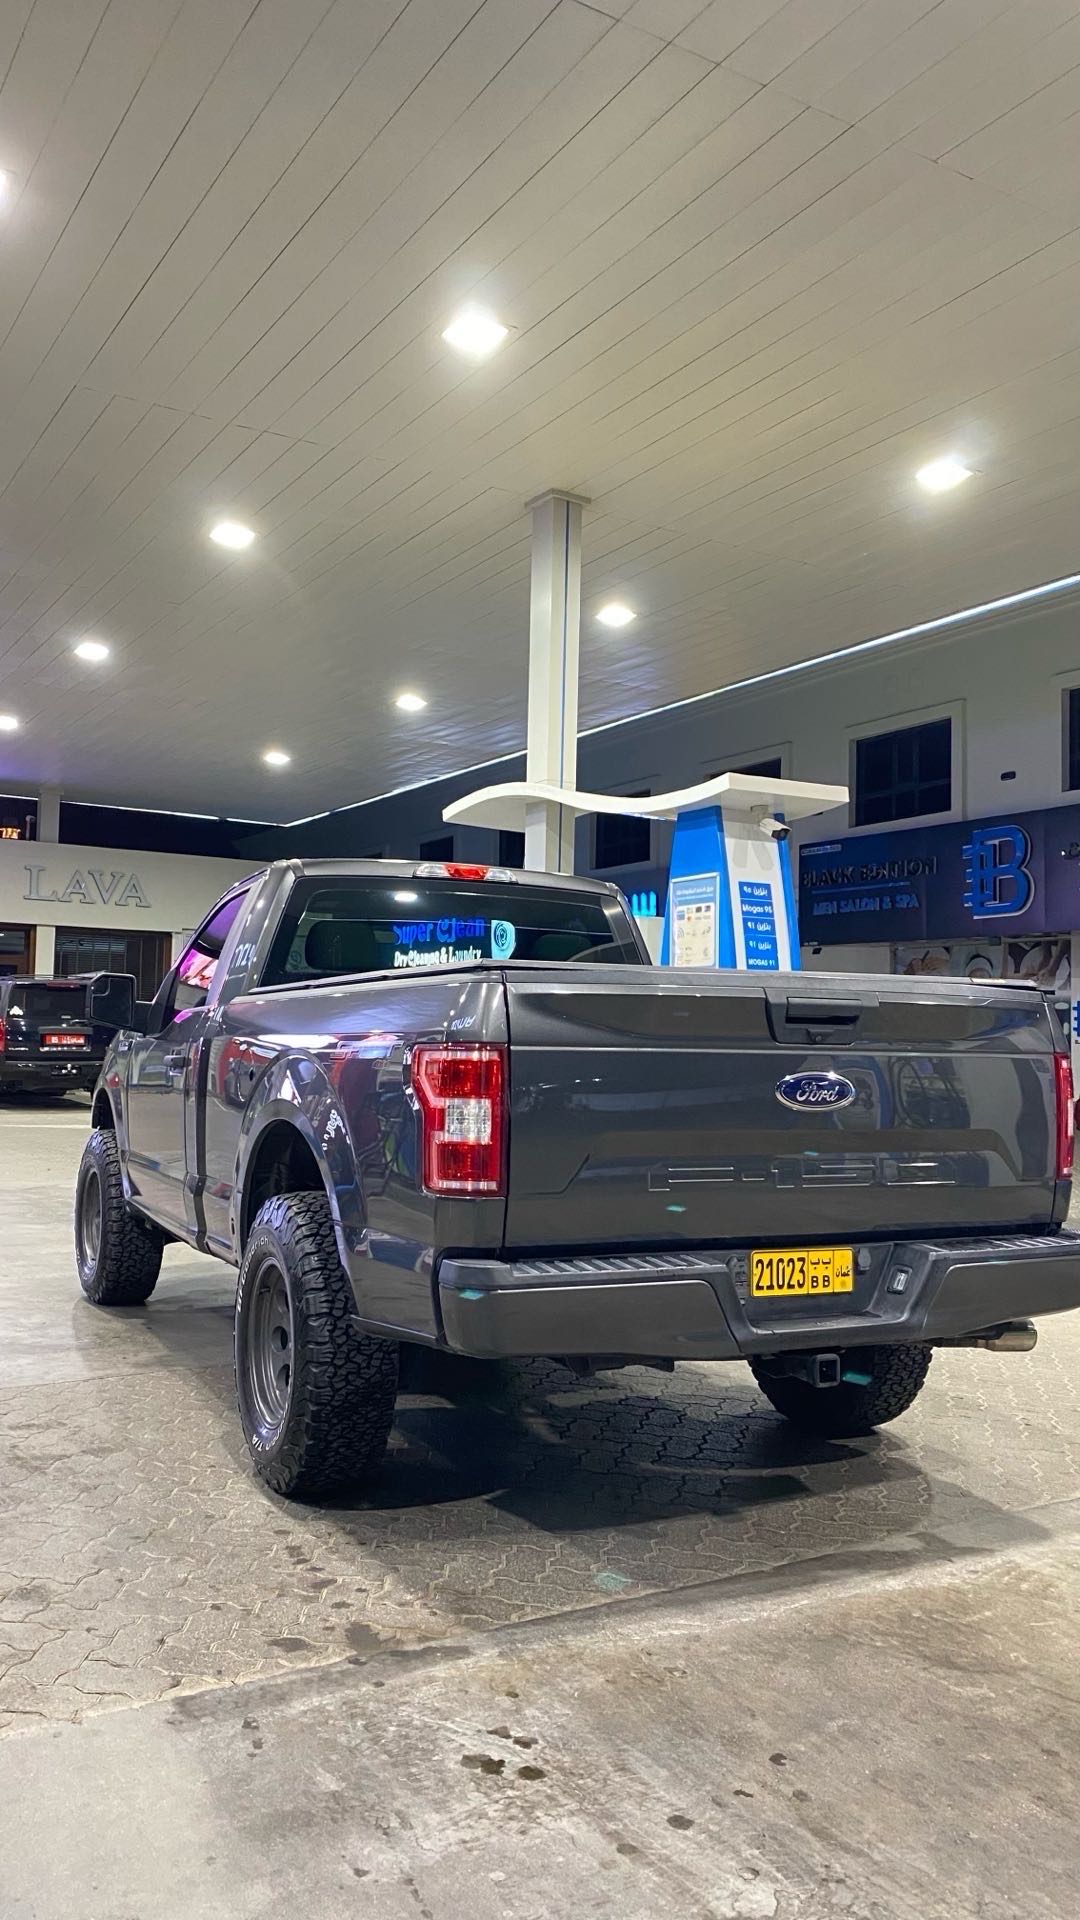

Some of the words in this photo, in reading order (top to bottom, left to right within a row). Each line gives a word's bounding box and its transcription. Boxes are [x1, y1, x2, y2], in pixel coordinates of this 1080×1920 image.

[23, 864, 152, 908] LAVA
[801, 865, 855, 887] BLACK
[742, 903, 764, 914] Mogas
[764, 904, 773, 913] 95
[813, 900, 838, 916] MEN
[840, 897, 880, 913] SALON
[895, 894, 920, 909] SPA
[748, 958, 768, 966] MOGAS
[796, 1080, 840, 1102] Ford
[755, 1256, 806, 1290] 21023
